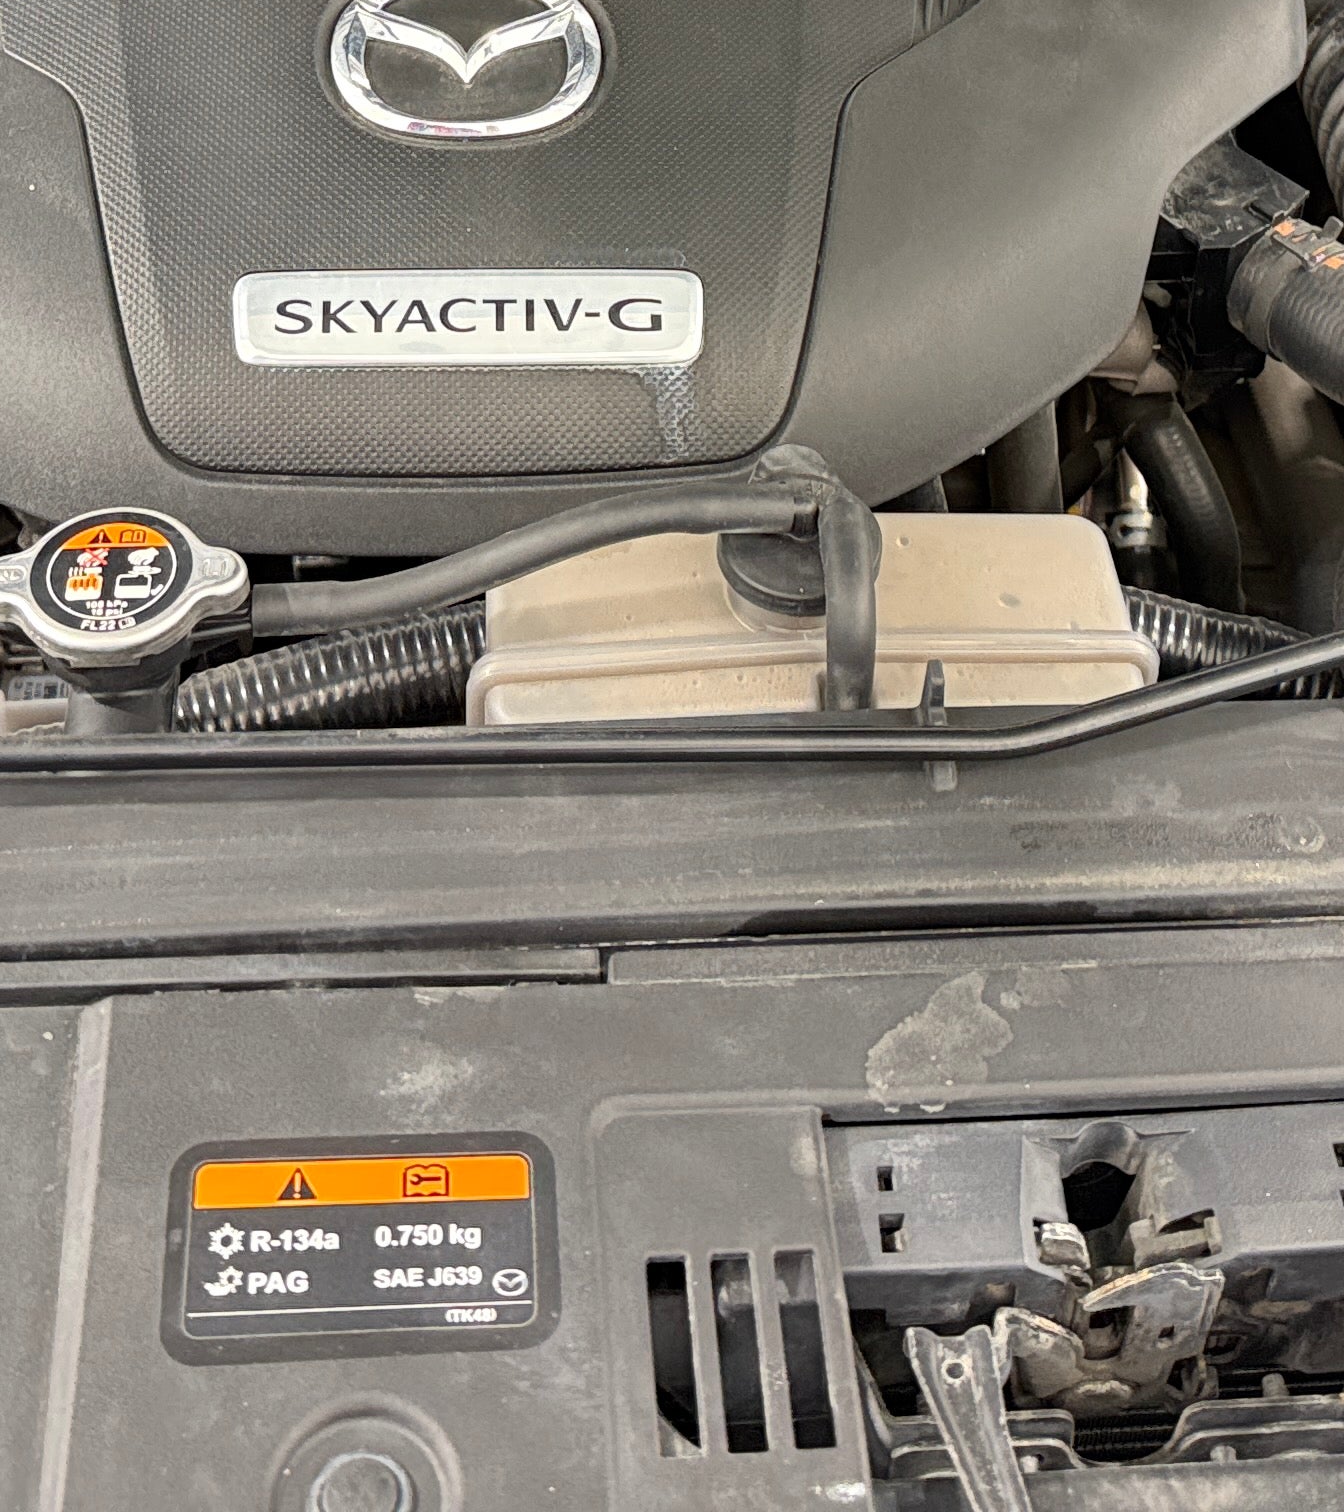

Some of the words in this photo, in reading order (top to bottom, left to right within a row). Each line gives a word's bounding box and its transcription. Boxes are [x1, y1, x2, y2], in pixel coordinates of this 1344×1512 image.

[273, 297, 663, 335] SKYACTIV-G
[80, 619, 116, 631] FL22
[249, 1228, 341, 1253] R-134a
[374, 1224, 444, 1248] 0.750
[448, 1223, 483, 1250] kg
[247, 1270, 310, 1295] PAG
[373, 1267, 424, 1288] SAE
[427, 1265, 484, 1287] J639
